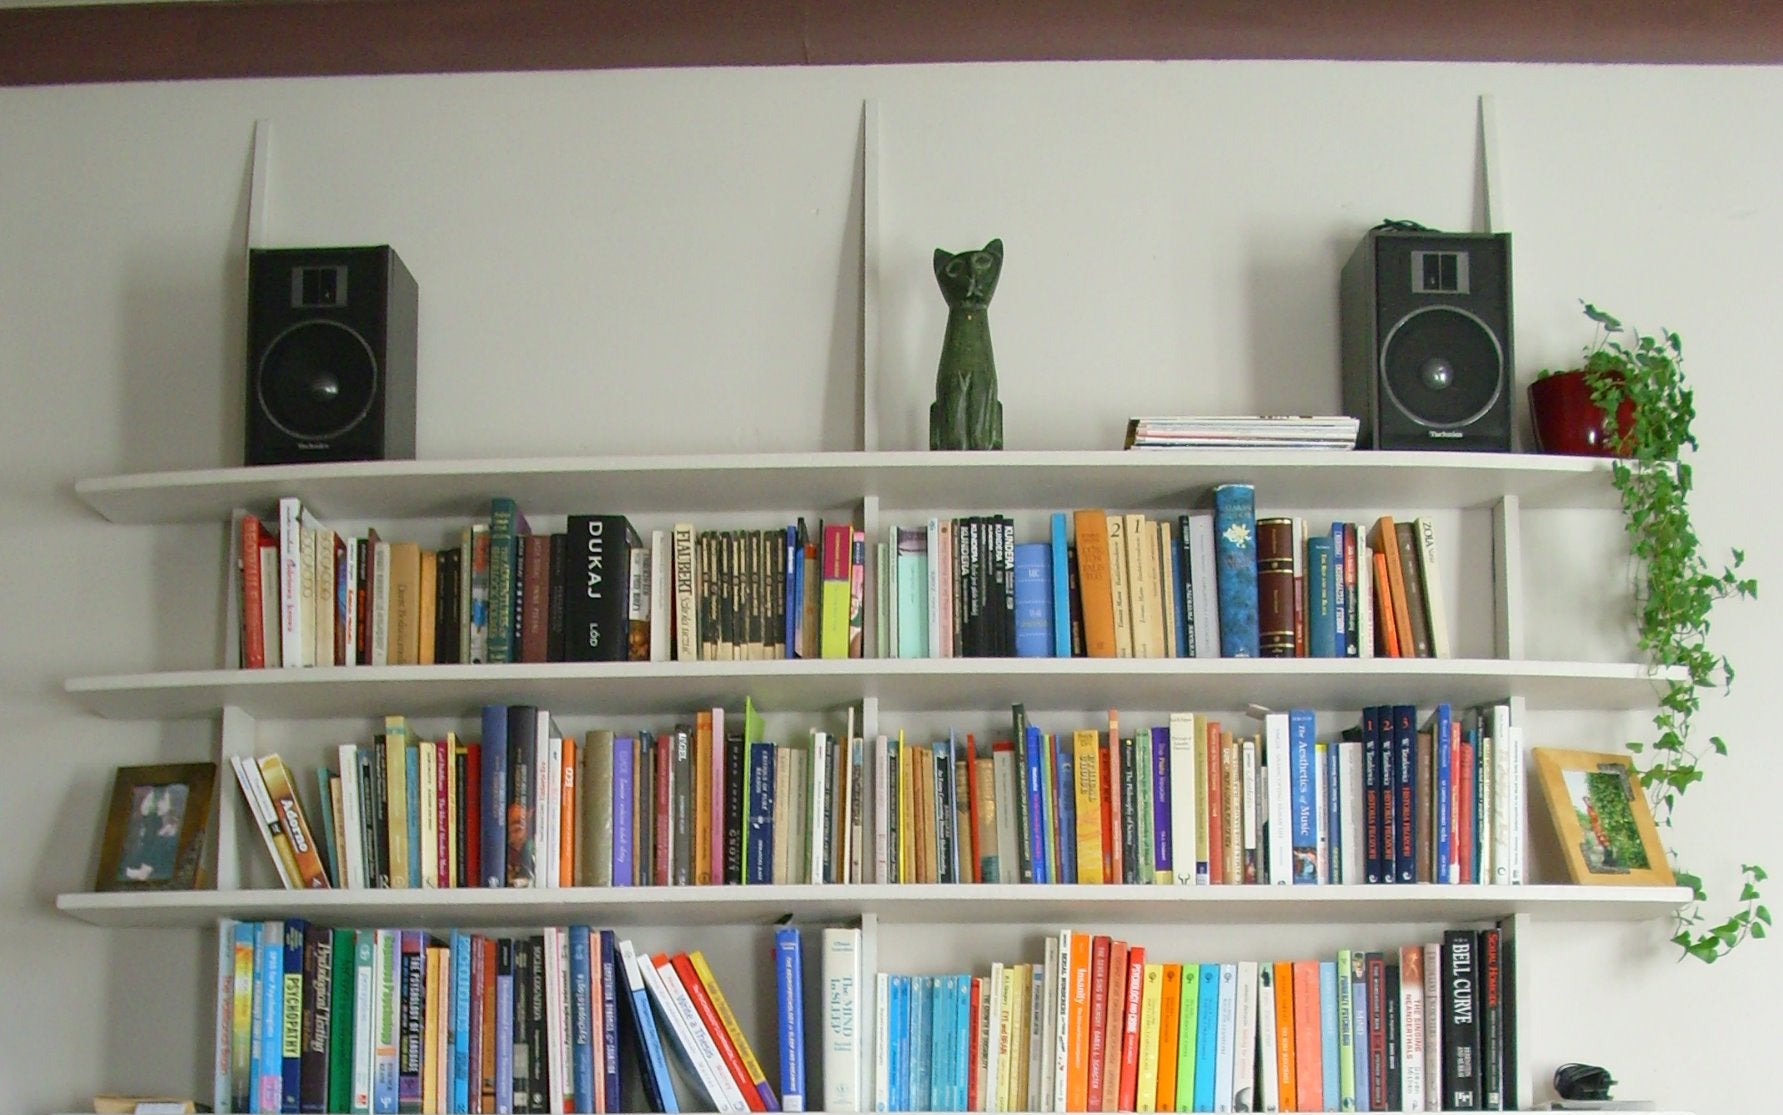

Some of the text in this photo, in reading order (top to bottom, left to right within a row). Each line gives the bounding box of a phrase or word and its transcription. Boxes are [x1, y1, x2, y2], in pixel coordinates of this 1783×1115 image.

[961, 526, 969, 575] KUNDERA
[970, 523, 978, 563] KUNDERA
[995, 524, 1003, 561] KUNDERA
[1004, 526, 1014, 569] KUNDERA
[1422, 522, 1435, 548] ZOLA
[587, 521, 603, 598] DUKAJ
[677, 530, 692, 595] FLAUBERT
[1299, 741, 1310, 793] Aesthetics
[281, 800, 308, 852] Adorno
[1300, 806, 1310, 836] Music
[311, 942, 330, 1053] Psychological Testing
[410, 973, 420, 1021] PSYCHOLOGY
[1074, 968, 1087, 1004] Insanity
[1452, 944, 1472, 1024] BELL CURVE
[286, 977, 300, 1054] PSYCHOPATHY
[830, 992, 840, 1034] SLEEP
[842, 1000, 853, 1037] MIND
[409, 1035, 419, 1073] LANGUAGE
